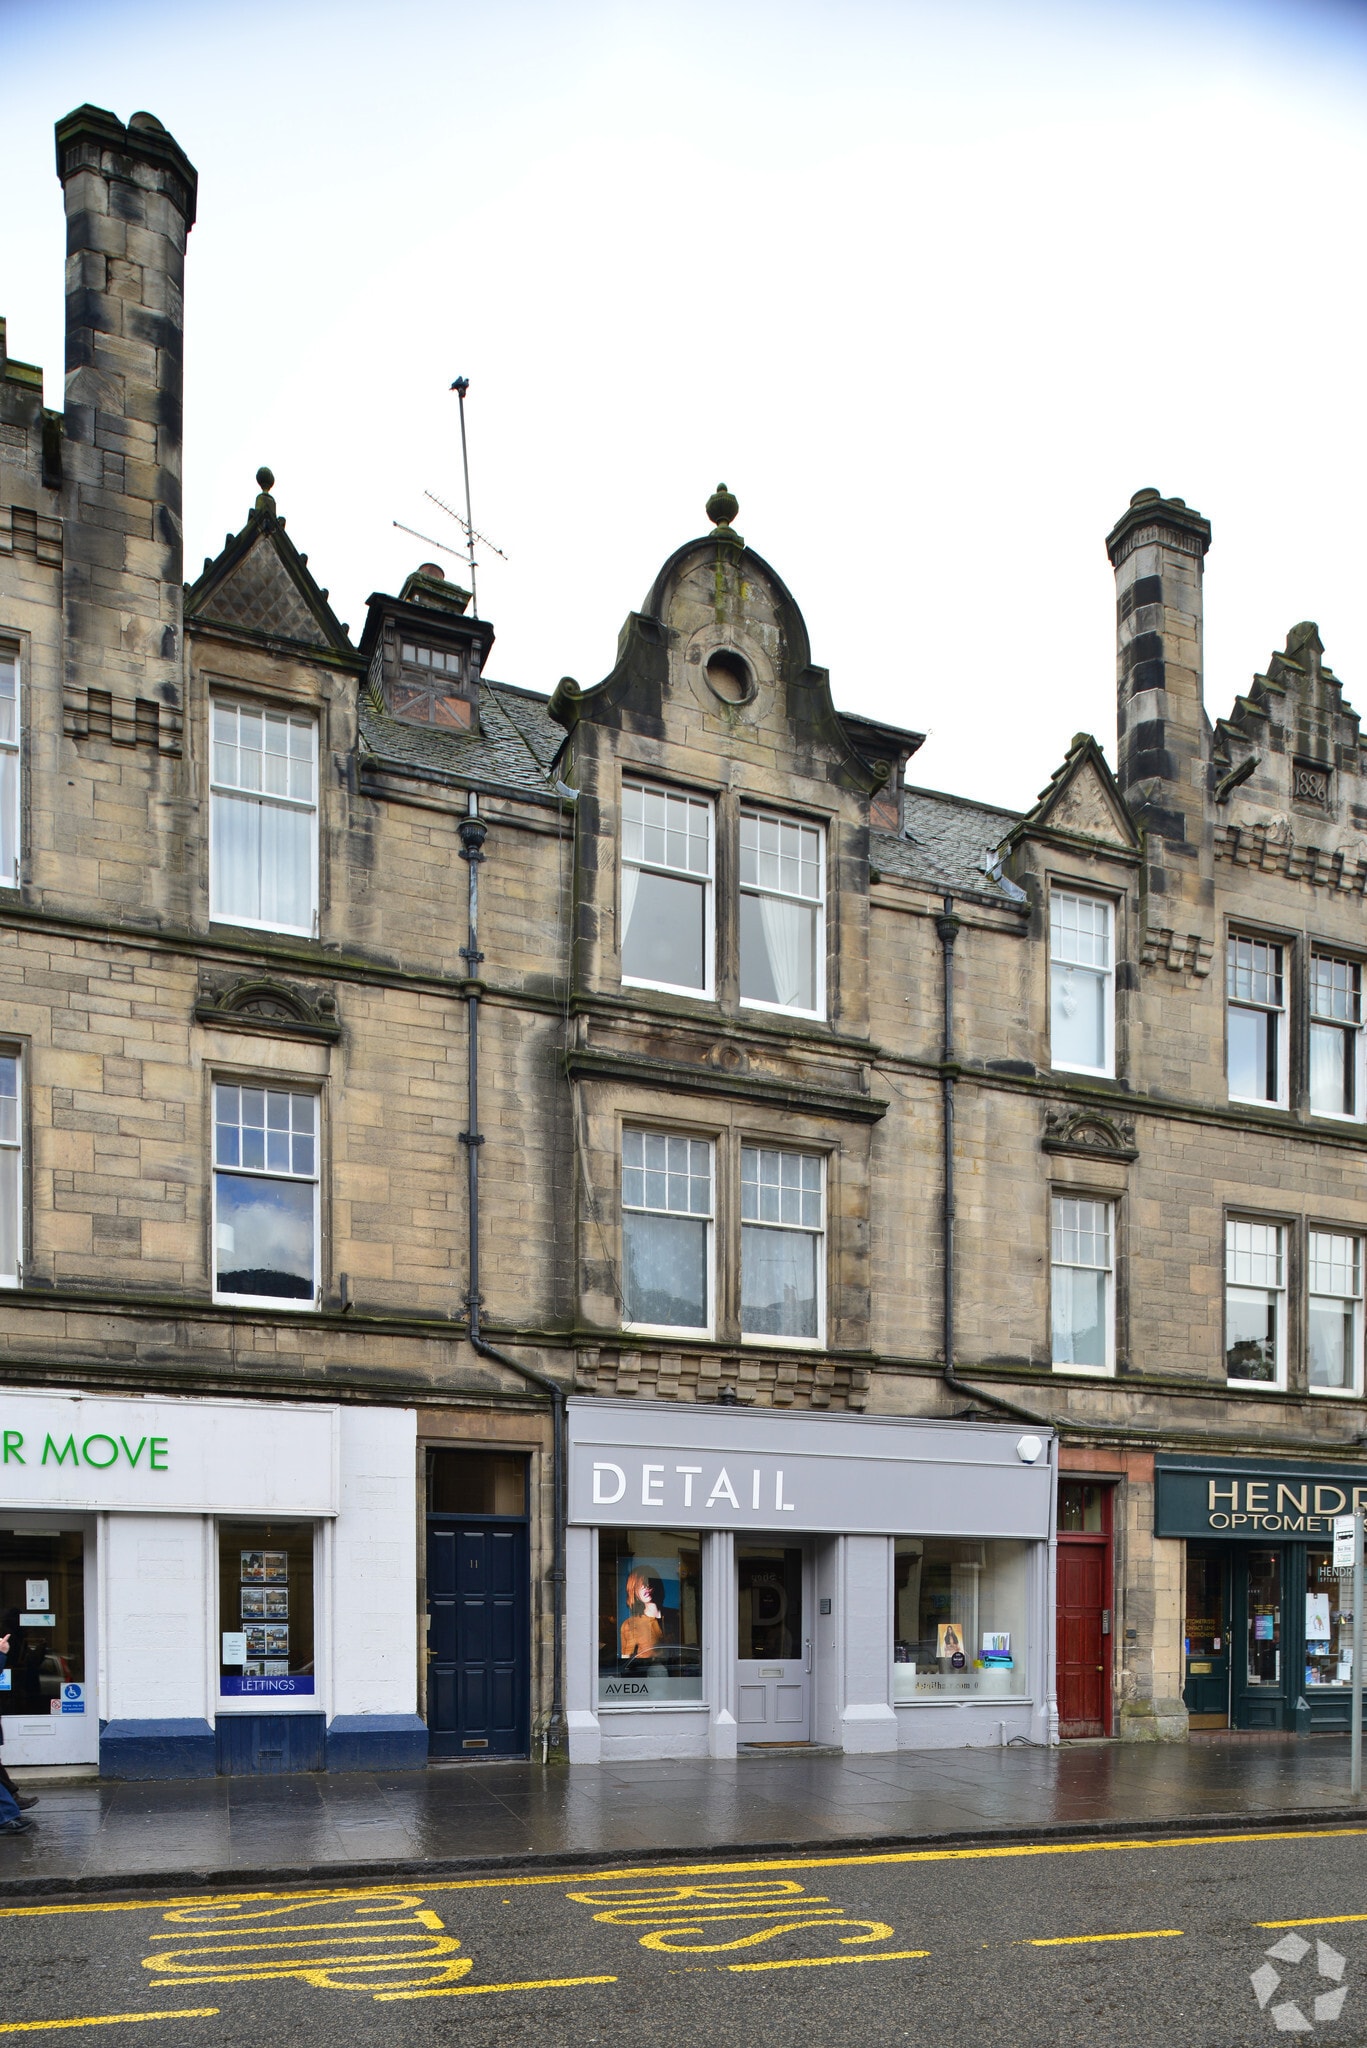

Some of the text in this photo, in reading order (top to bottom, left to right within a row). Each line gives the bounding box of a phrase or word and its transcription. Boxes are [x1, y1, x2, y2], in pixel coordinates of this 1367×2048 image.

[1295, 769, 1326, 800] 1886
[3, 1430, 168, 1470] R MOVE
[593, 1462, 795, 1511] DETAIL
[1209, 1512, 1367, 1532] OPTOMET
[1320, 1566, 1355, 1577] HENDR
[241, 1680, 295, 1691] LETTINGS
[605, 1683, 649, 1694] AVEDA
[565, 1880, 894, 1952] BUS
[141, 1895, 473, 1990] STOP
